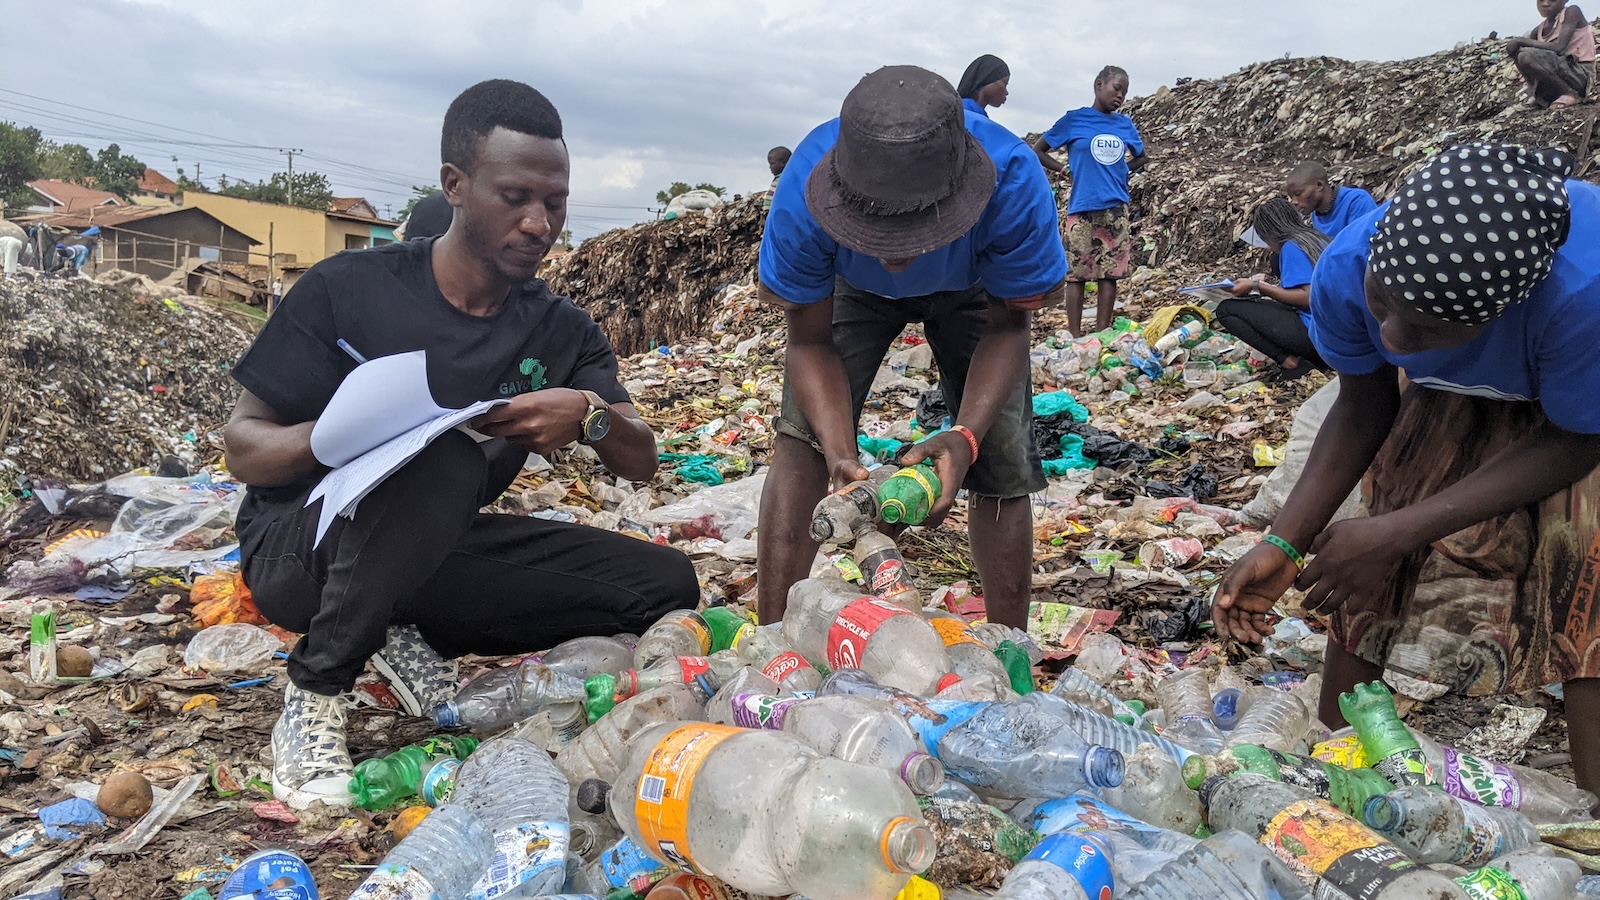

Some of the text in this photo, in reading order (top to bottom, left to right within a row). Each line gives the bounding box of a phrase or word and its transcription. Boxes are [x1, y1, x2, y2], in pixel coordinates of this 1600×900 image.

[1097, 139, 1120, 149] END
[835, 616, 870, 640] RECYCLE ME
[280, 866, 299, 874] Pot
[1073, 852, 1089, 870] pepsi
[1363, 877, 1383, 896] Litre
